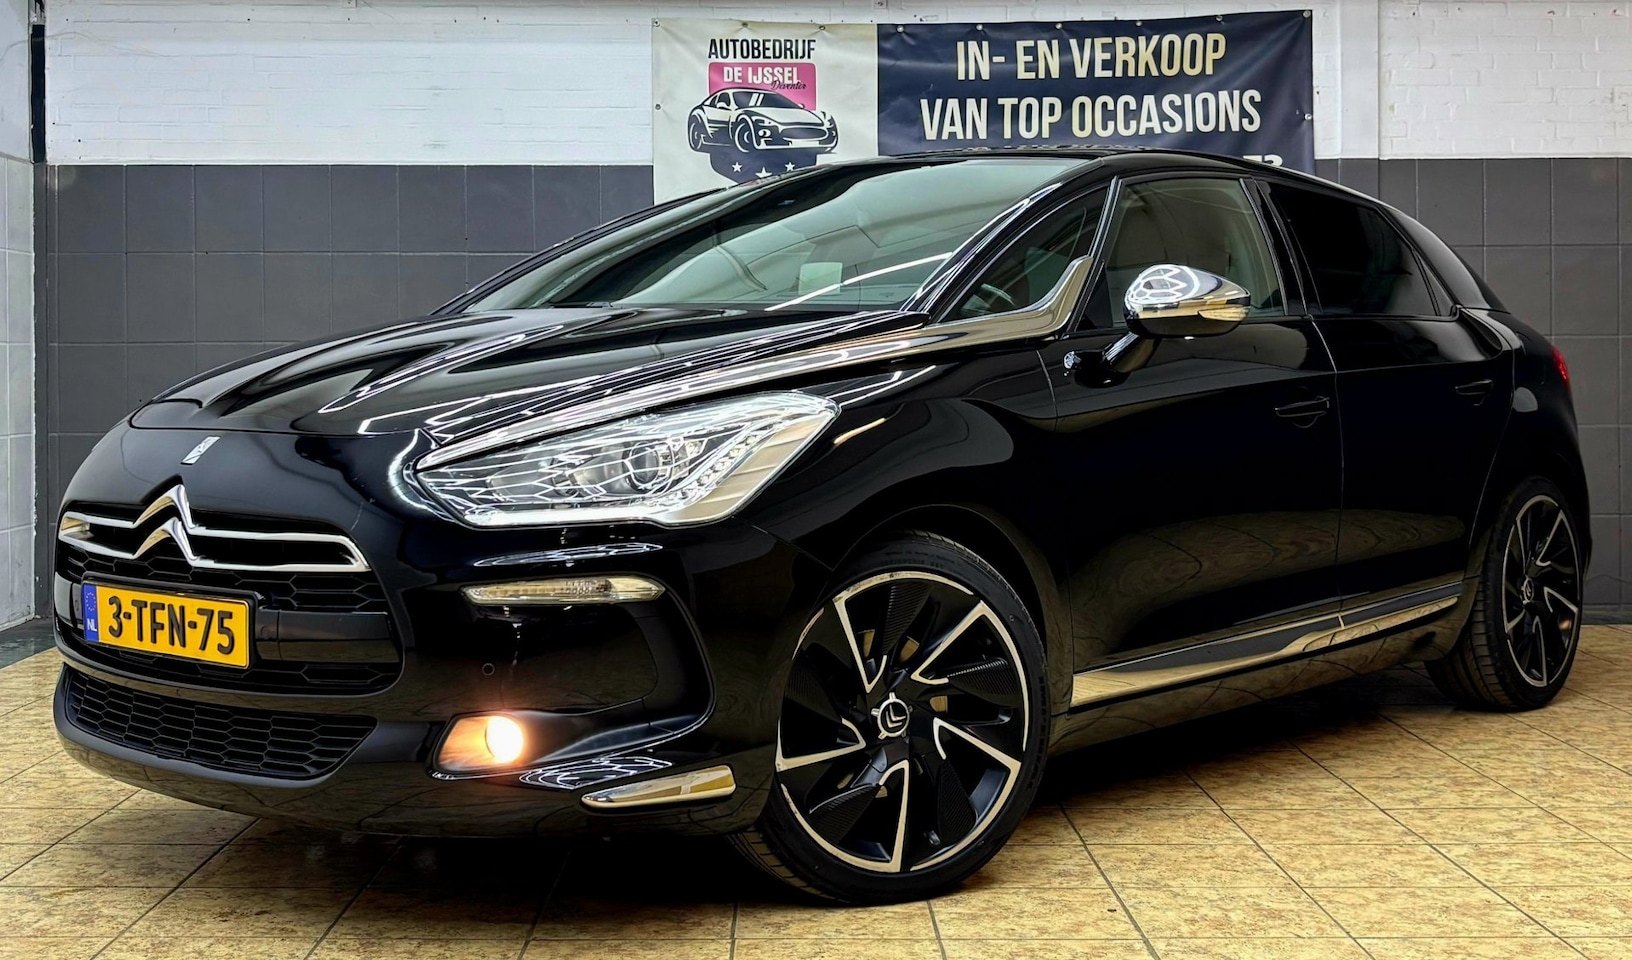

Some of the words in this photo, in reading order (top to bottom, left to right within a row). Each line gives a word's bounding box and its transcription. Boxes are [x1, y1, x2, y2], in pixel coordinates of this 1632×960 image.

[708, 38, 816, 60] AUTOBEDRIJF
[956, 40, 1005, 81] IN-
[1016, 39, 1060, 79] EN
[1069, 33, 1227, 78] VERKOOP
[723, 66, 743, 83] DE
[747, 66, 801, 84] IJSSEL
[770, 80, 807, 90] Deventer
[920, 98, 988, 140] VAN
[998, 97, 1062, 139] TOP
[1072, 89, 1262, 137] OCCASIONS
[86, 617, 98, 632] NL
[108, 595, 236, 655] 3-TFN-75
